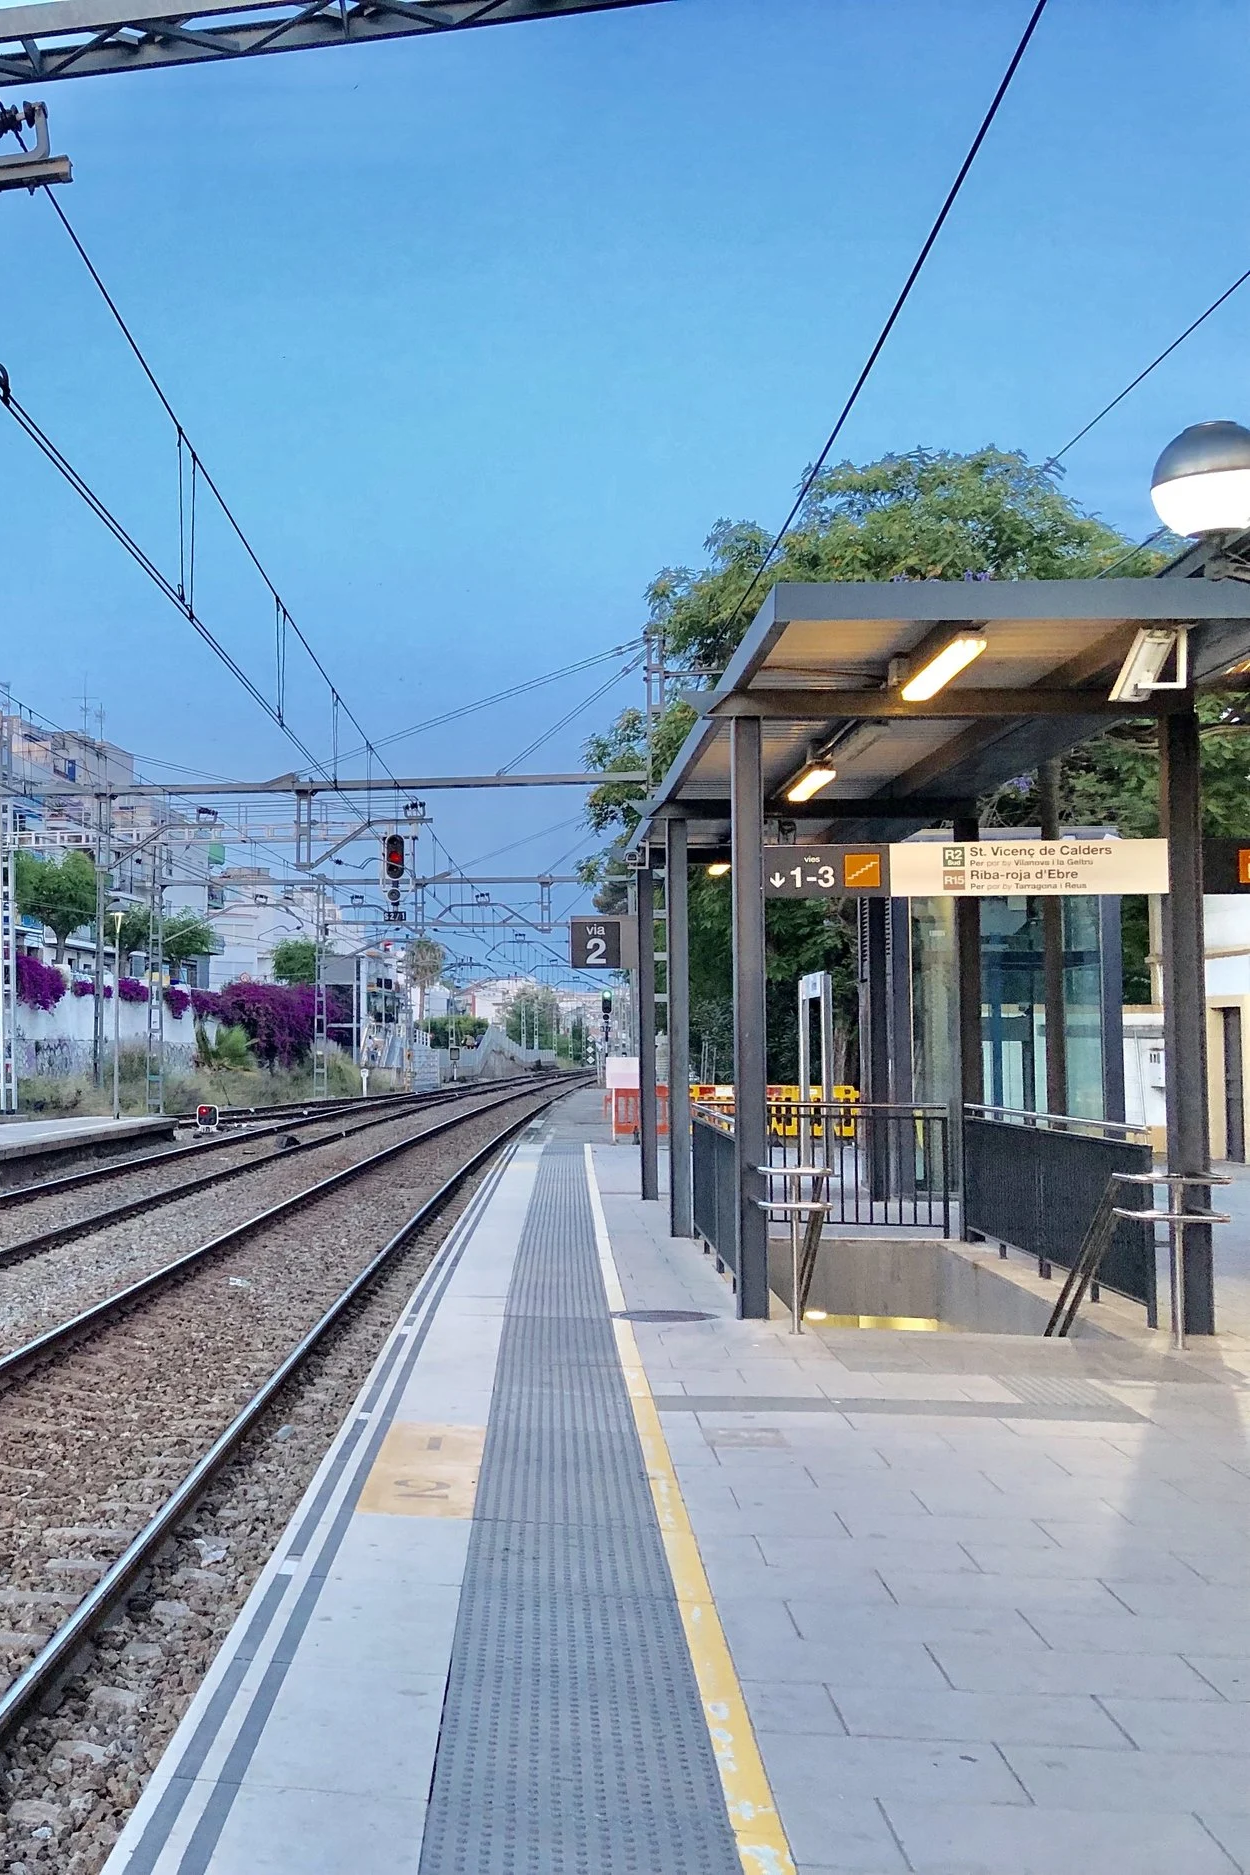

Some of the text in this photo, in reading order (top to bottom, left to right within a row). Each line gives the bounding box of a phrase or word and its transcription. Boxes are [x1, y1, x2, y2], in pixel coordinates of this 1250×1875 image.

[945, 849, 963, 860] R2
[970, 845, 1112, 858] St. Vicenç de Calders
[803, 855, 821, 863] vies
[790, 865, 835, 888] 1-3
[944, 875, 964, 885] R15
[970, 868, 1079, 881] Riba-roja d'Ebre
[1014, 882, 1057, 890] Tarragona
[384, 912, 405, 920] S2/1
[585, 923, 606, 936] via
[586, 937, 607, 965] 2
